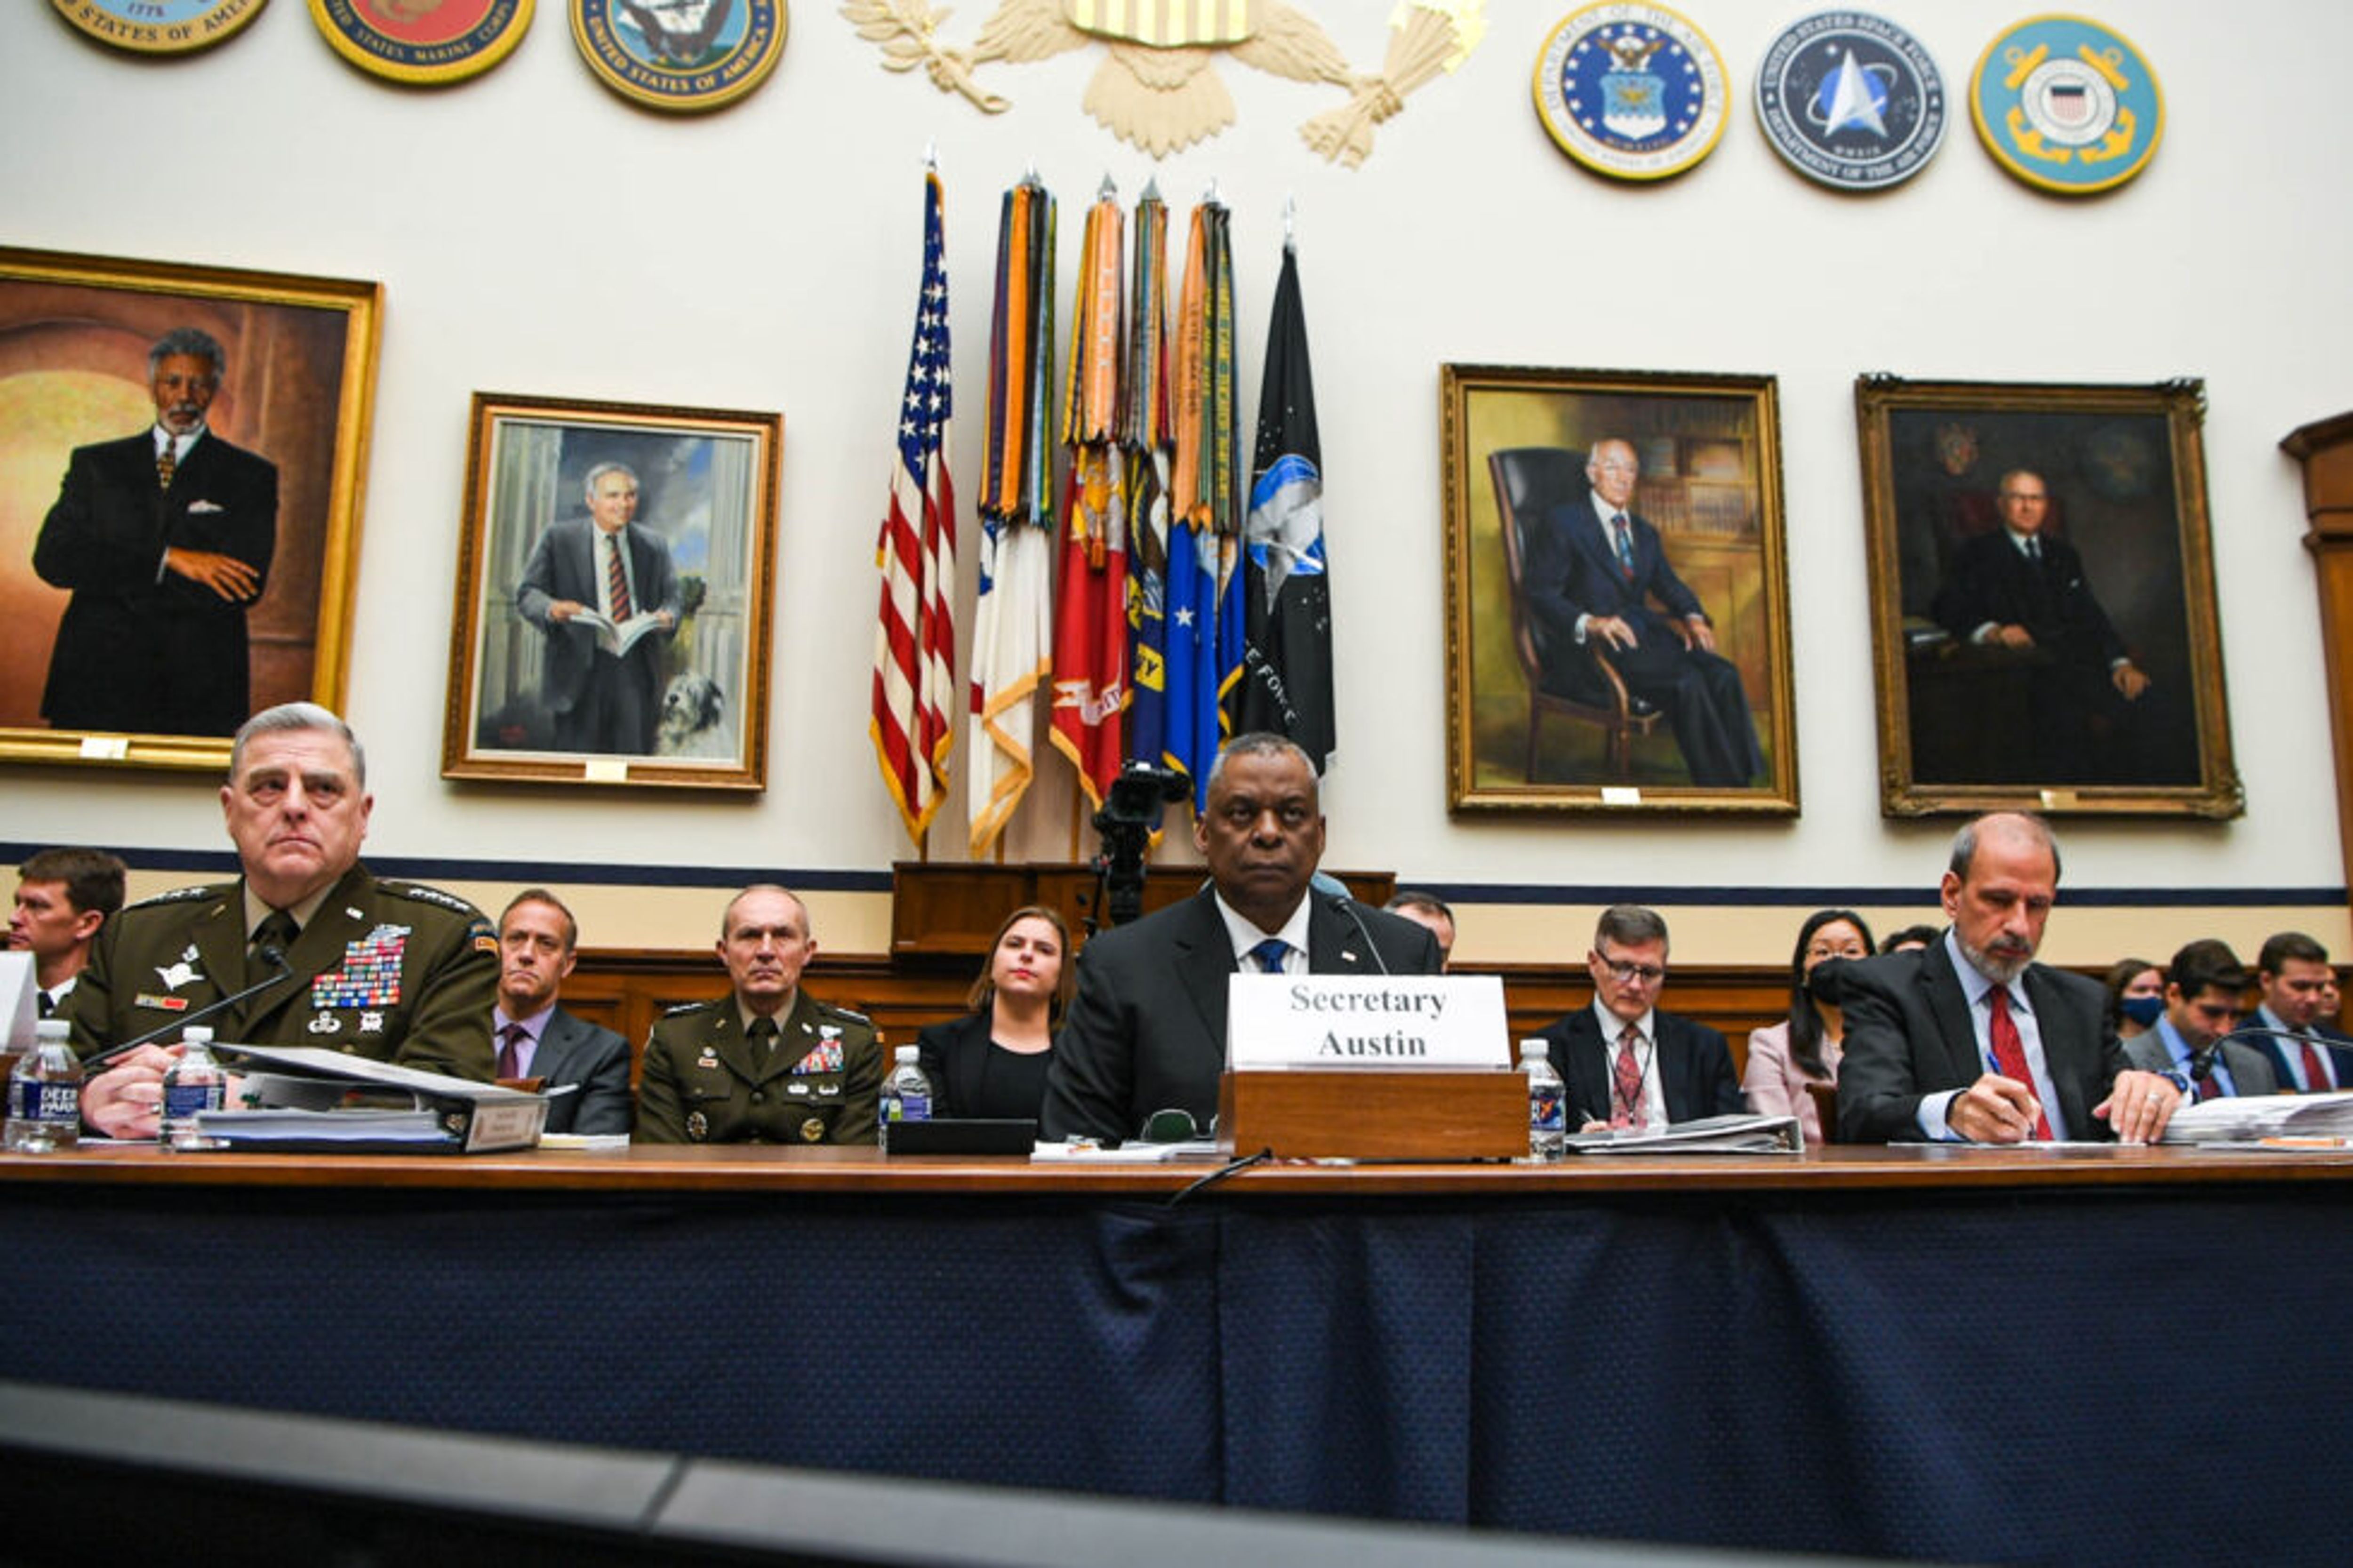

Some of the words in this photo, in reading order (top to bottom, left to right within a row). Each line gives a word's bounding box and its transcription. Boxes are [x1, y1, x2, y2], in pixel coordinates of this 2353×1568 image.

[79, 8, 159, 40] STATES
[167, 26, 192, 40] OF
[415, 42, 471, 60] MARINE
[589, 17, 628, 68] UNITED
[629, 68, 690, 91] STATES
[696, 77, 718, 90] OF
[723, 27, 768, 81] AMERICA
[1291, 984, 1446, 1020] Secretary
[1319, 1029, 1426, 1056] Austin
